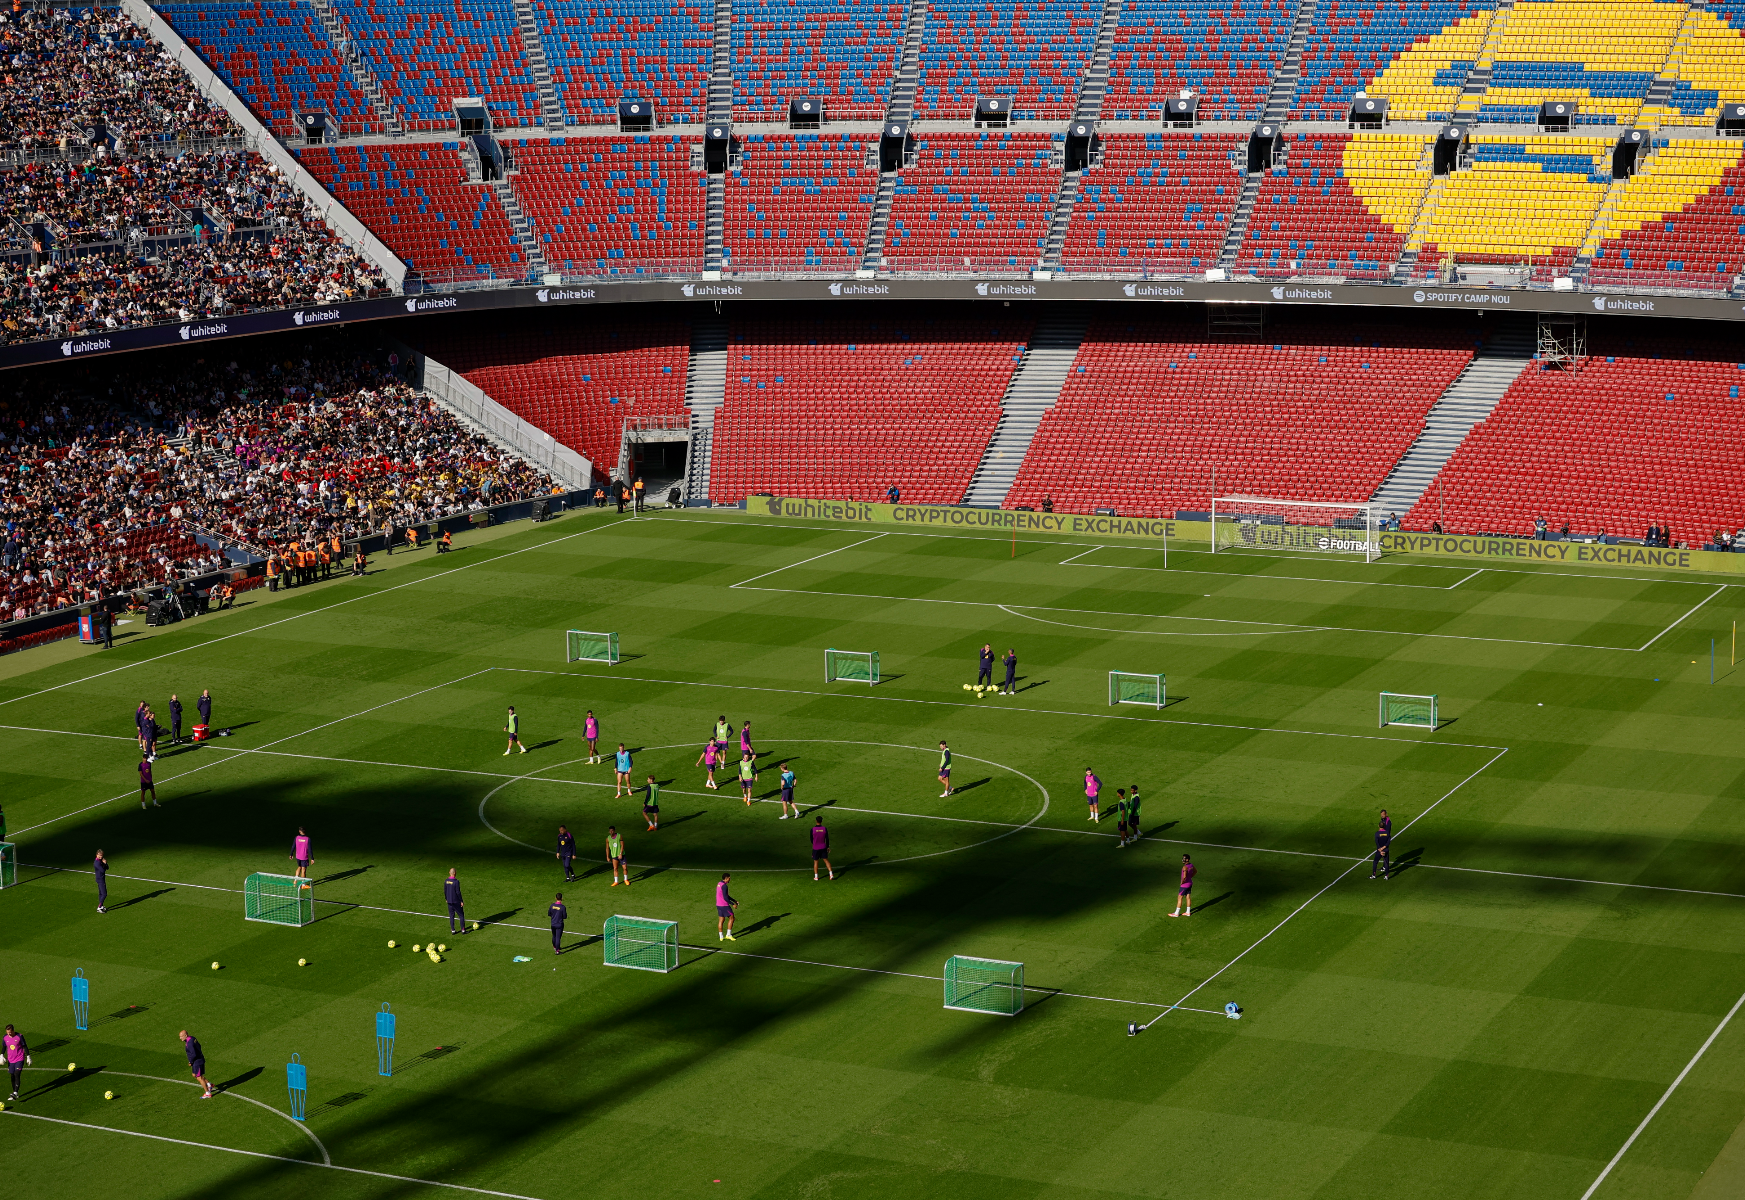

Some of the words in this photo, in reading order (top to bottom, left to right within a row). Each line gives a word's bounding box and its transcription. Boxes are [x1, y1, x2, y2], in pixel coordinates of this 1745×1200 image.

[550, 288, 596, 300] whitebit
[696, 285, 743, 296] whitebit
[843, 285, 890, 294] whitebit
[990, 285, 1037, 295] whitebit
[1138, 286, 1184, 296] whitebit
[1286, 289, 1333, 299] whitebit
[417, 297, 457, 310] whitebit
[1426, 292, 1463, 303] SPOTIFY
[1464, 294, 1490, 304] CAMP
[1491, 295, 1510, 305] NOU
[1607, 300, 1655, 311] whitebit
[304, 309, 340, 323] whitebit
[191, 323, 228, 337] whitebit
[73, 338, 111, 353] whitebit
[785, 498, 872, 522] whitebit
[892, 506, 1066, 532] CRYPTOCURRENCY
[1072, 516, 1176, 537] EXCHANGE
[1380, 534, 1570, 561] CRYPTOCURRENCY
[1577, 545, 1691, 568] EXCHANGE
